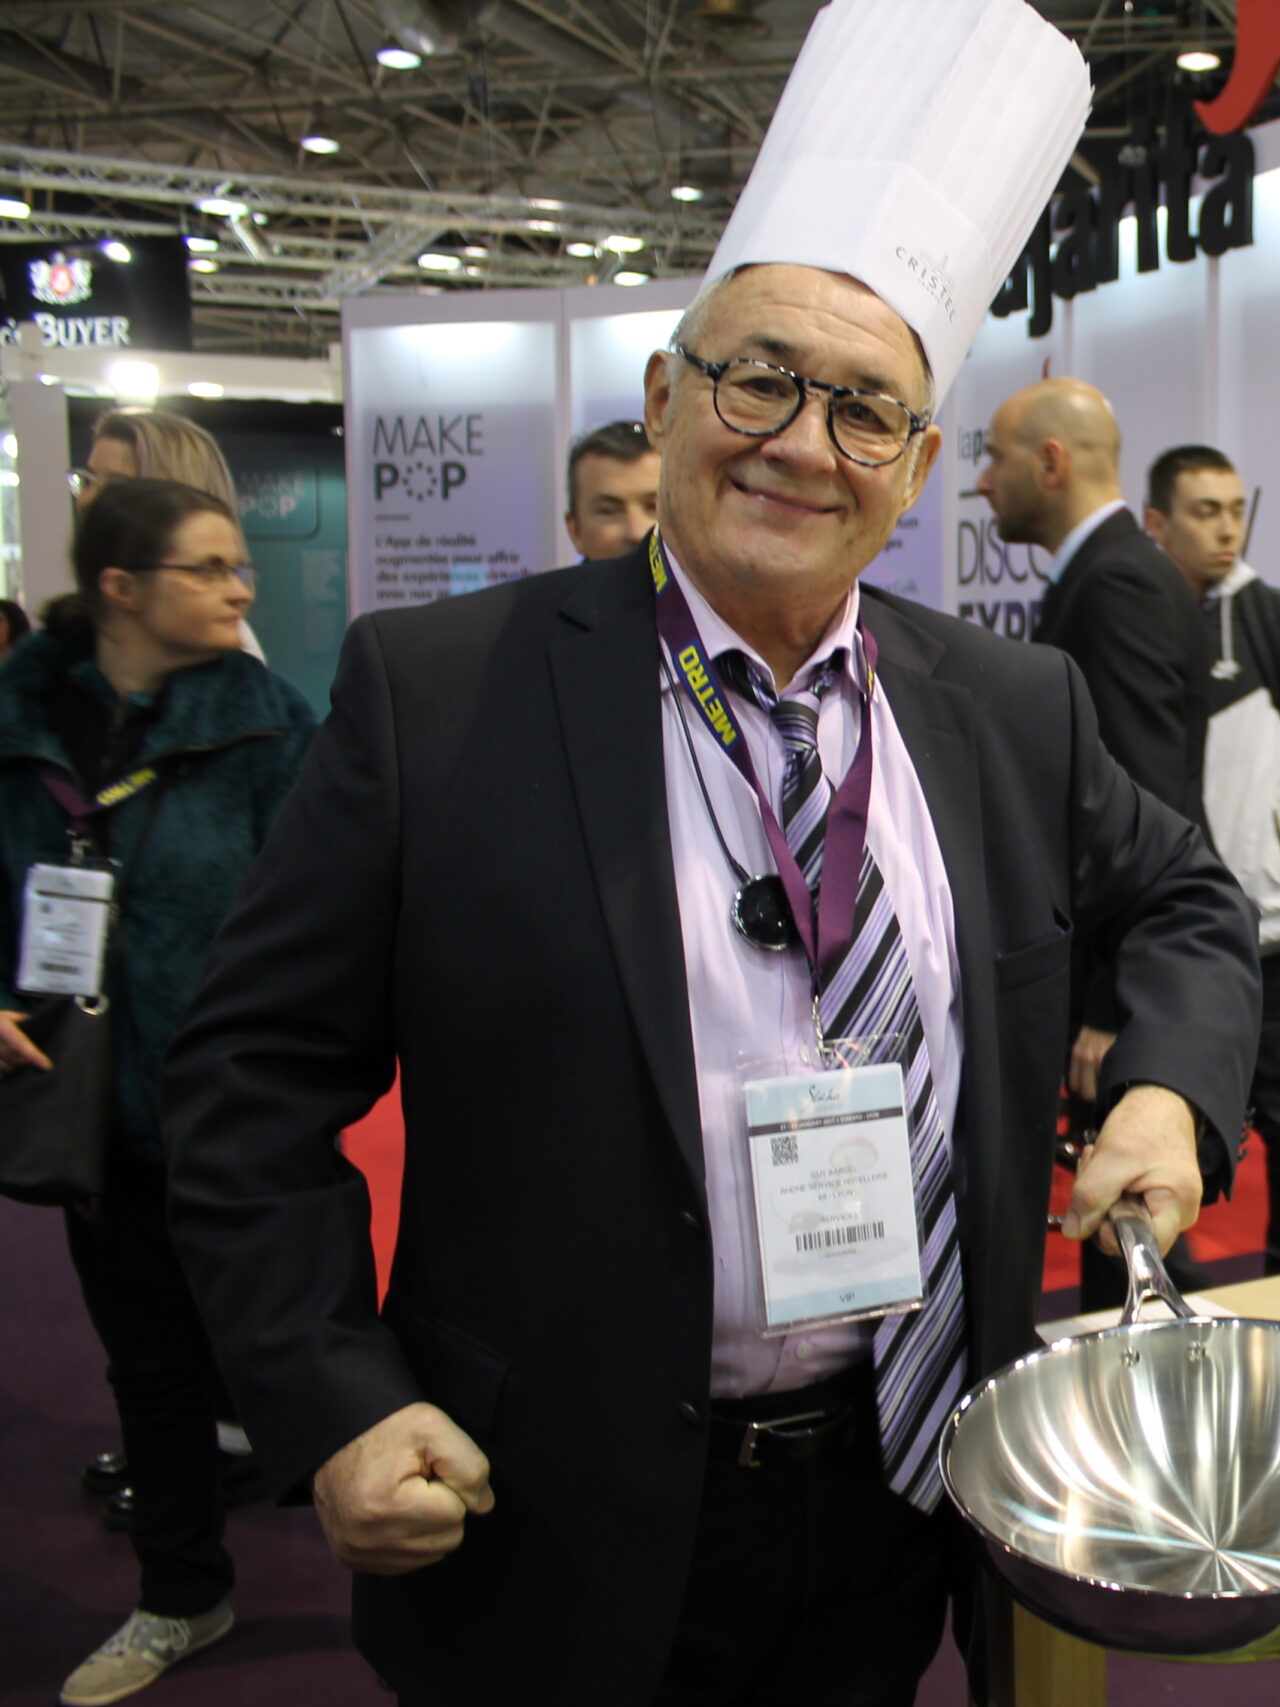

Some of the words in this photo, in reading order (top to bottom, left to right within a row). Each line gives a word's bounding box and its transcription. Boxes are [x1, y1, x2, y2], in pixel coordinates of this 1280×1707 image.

[895, 246, 957, 323] CRISTEL
[372, 414, 484, 456] MAKE
[677, 644, 738, 746] METRO
